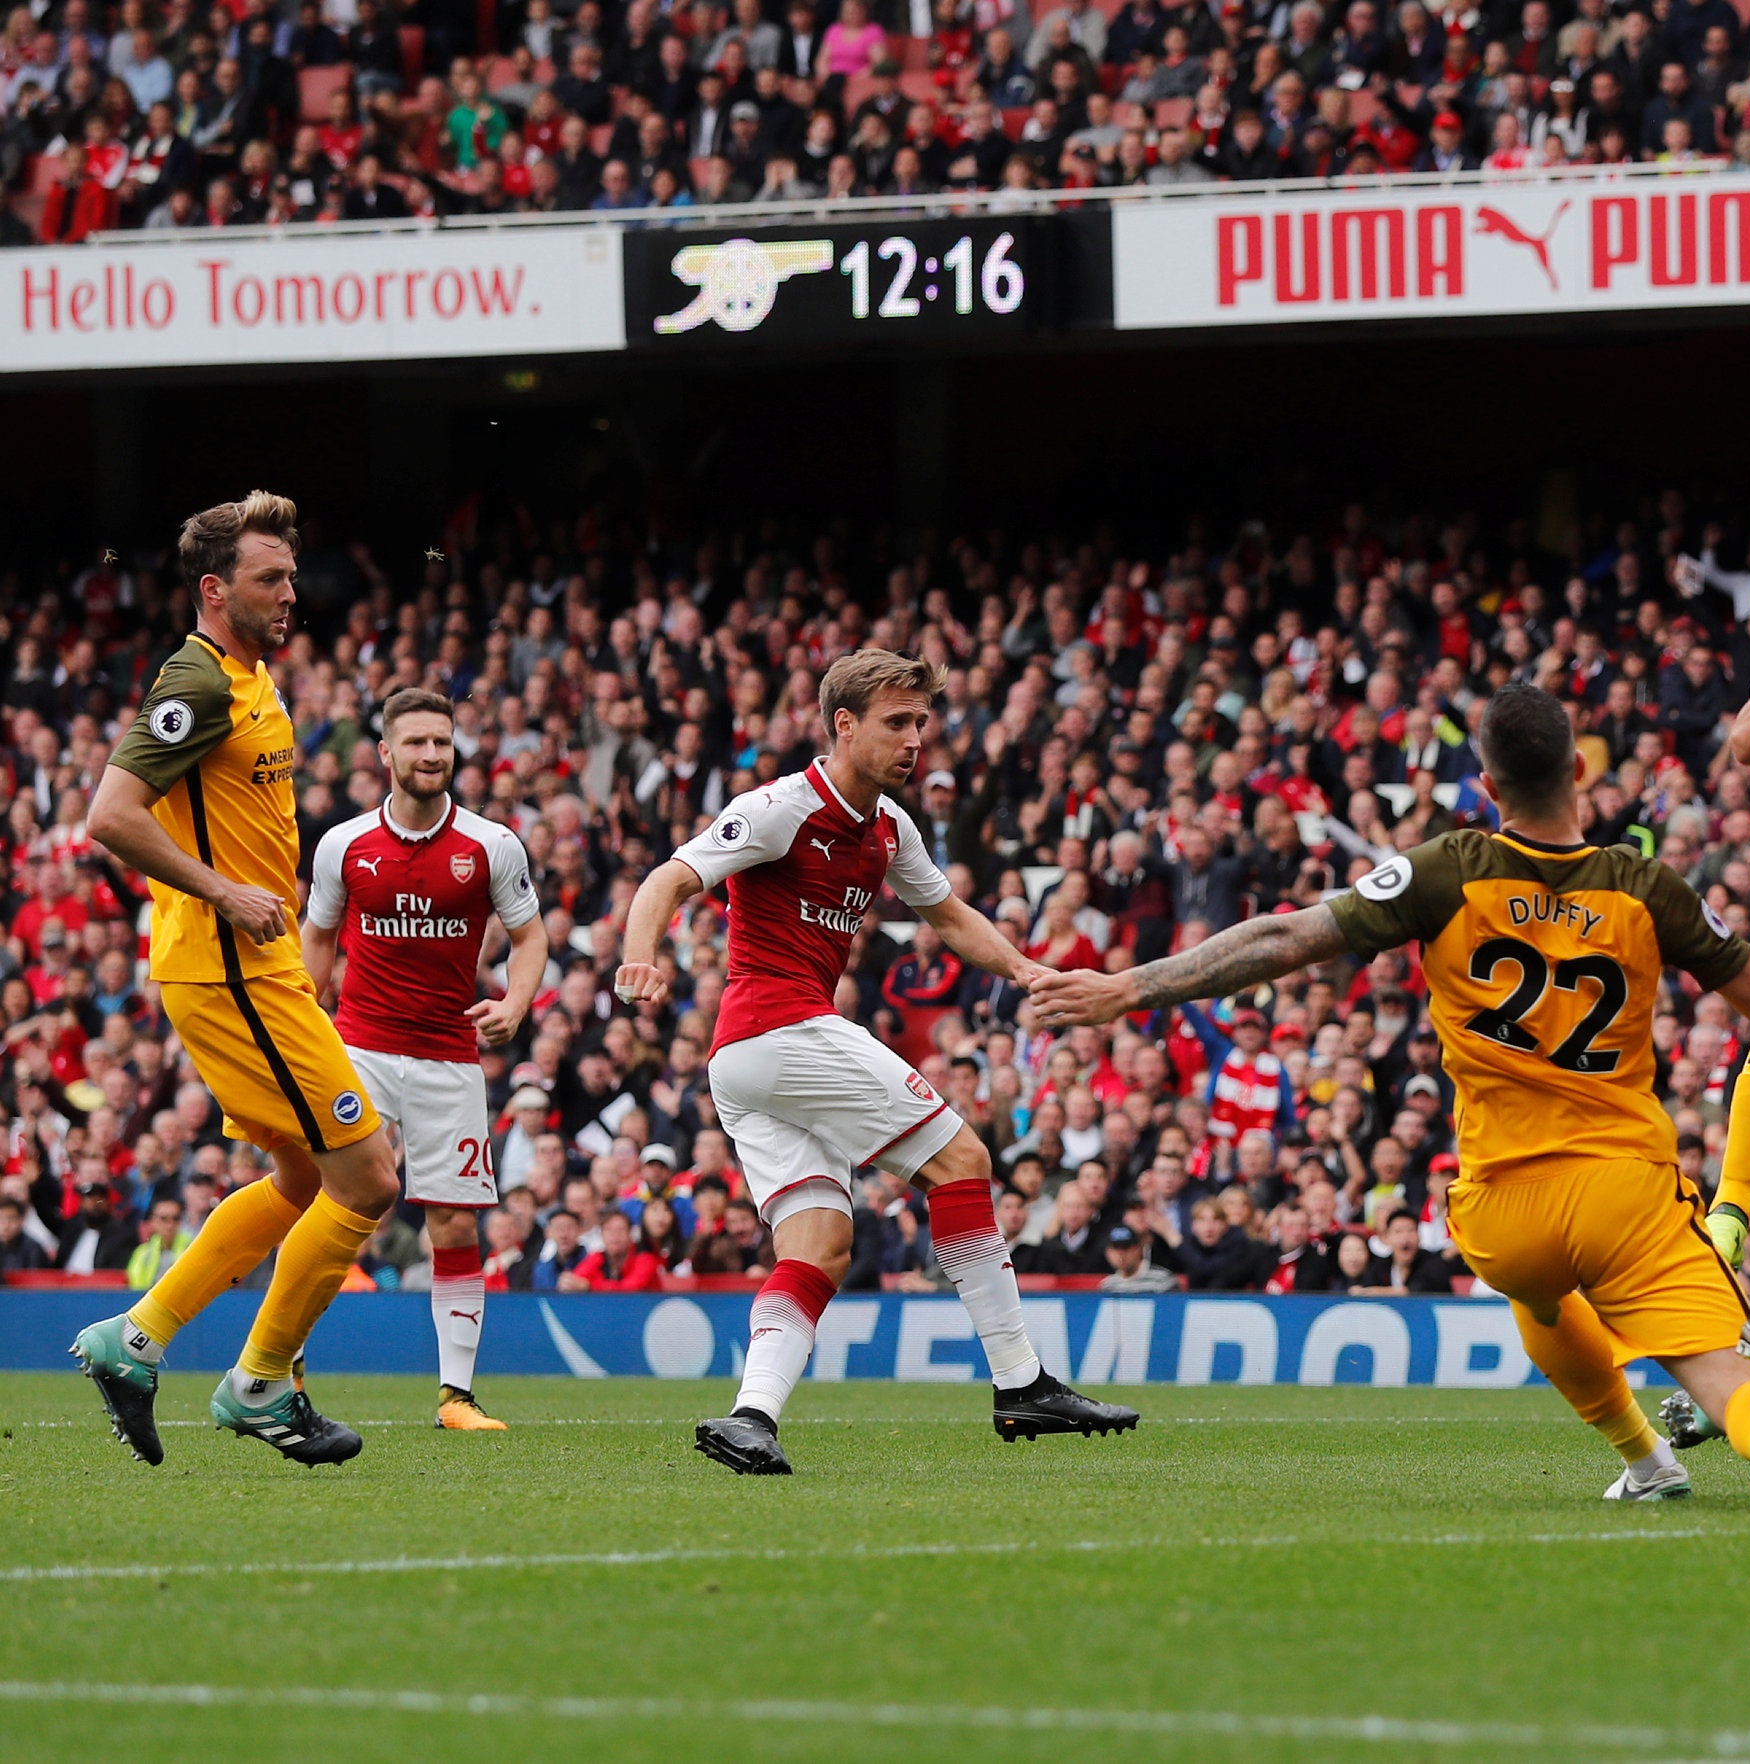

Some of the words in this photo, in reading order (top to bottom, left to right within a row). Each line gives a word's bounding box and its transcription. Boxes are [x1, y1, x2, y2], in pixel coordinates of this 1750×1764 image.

[840, 233, 1024, 320] 12:16
[1216, 204, 1464, 307] PUMA
[22, 265, 176, 332] Hello
[204, 258, 541, 328] Tomorrow.
[360, 911, 469, 939] Emirates
[395, 893, 432, 916] Fly
[842, 886, 873, 911] Fly
[1508, 893, 1603, 937] DUFFY
[1465, 937, 1628, 1074] 22
